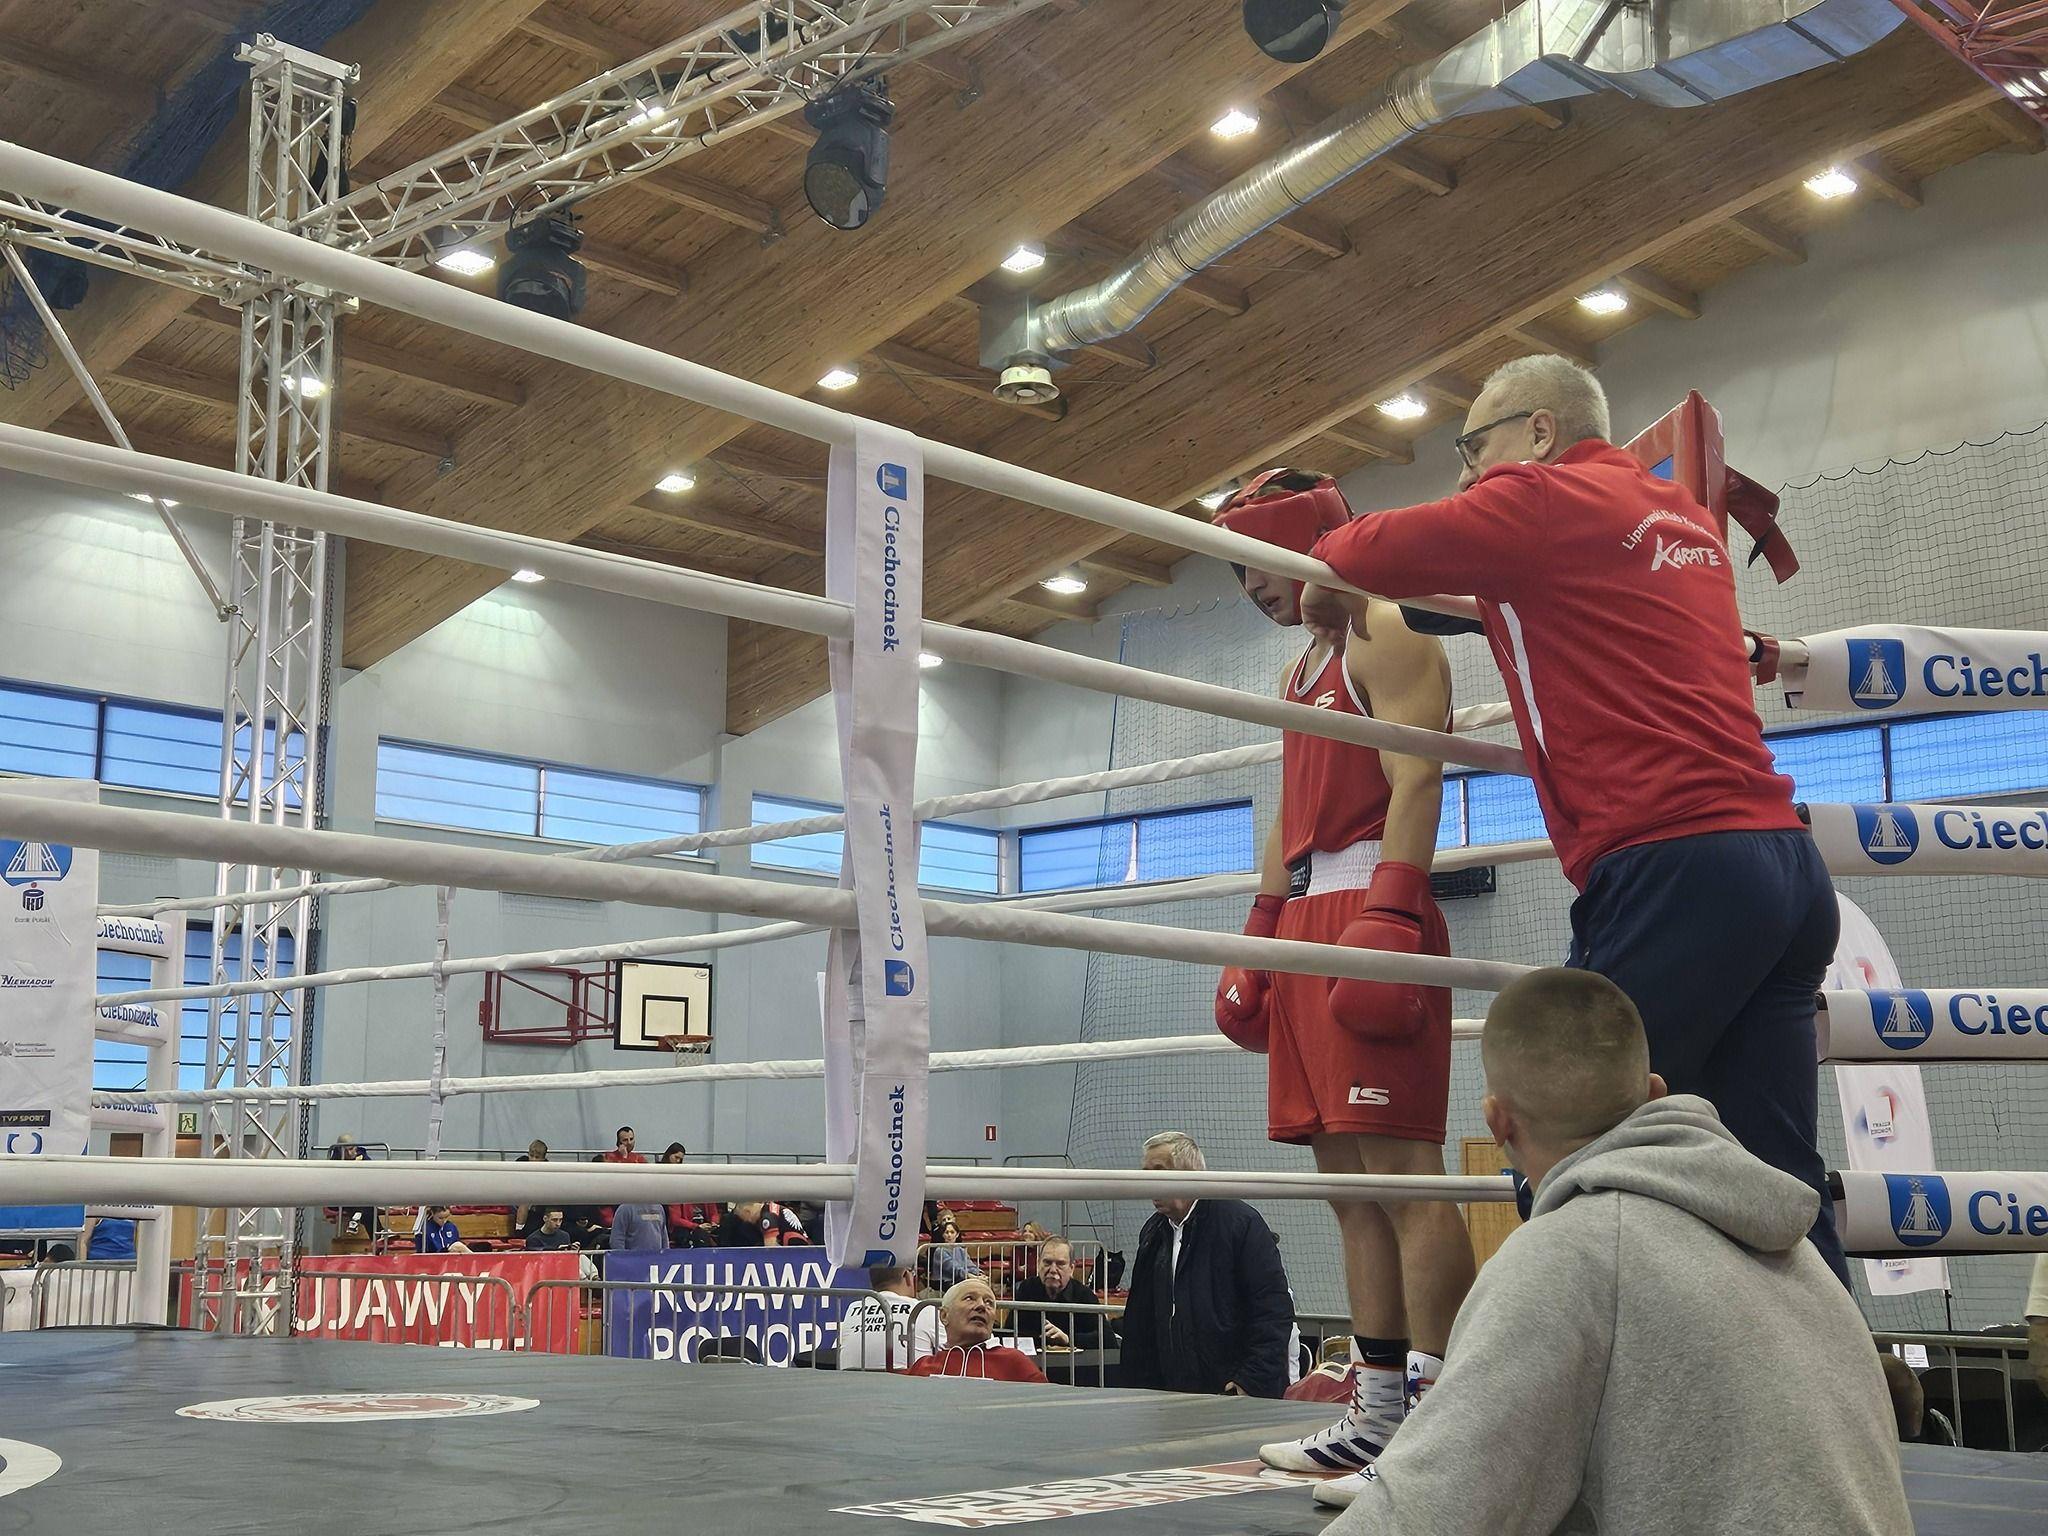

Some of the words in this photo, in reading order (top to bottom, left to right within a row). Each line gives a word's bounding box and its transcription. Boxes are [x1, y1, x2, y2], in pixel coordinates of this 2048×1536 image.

[884, 506, 901, 652] Ciechocinek
[879, 803, 904, 952] Ciechocinek
[878, 1084, 905, 1241] Ciechocinek
[1968, 1190, 2048, 1236] Cie
[649, 1262, 838, 1314] KUJAWY
